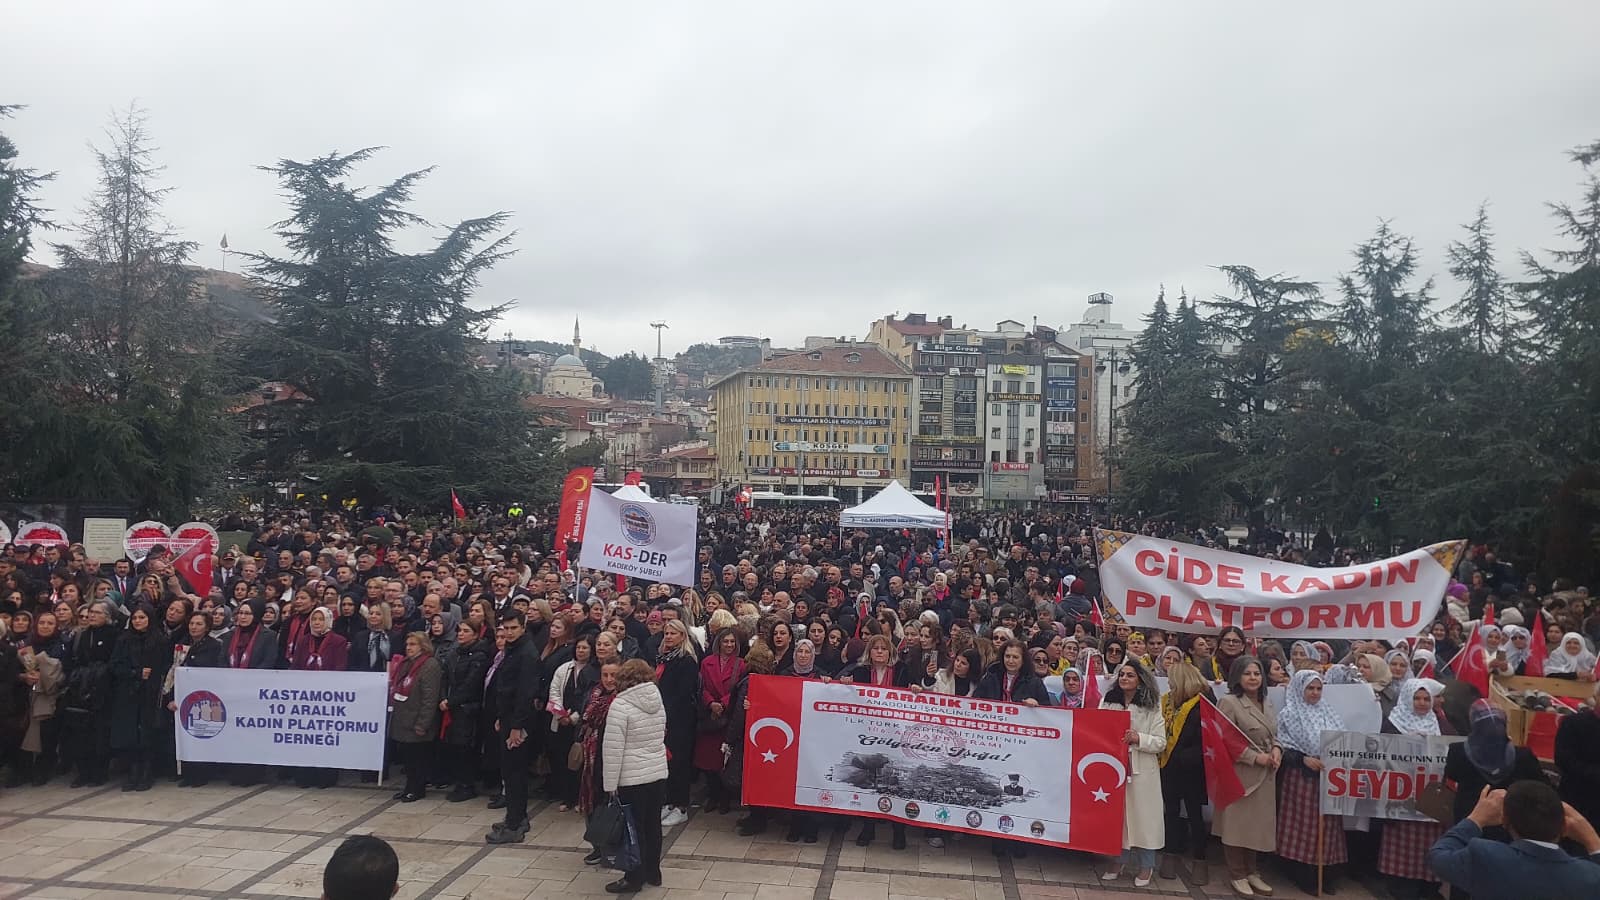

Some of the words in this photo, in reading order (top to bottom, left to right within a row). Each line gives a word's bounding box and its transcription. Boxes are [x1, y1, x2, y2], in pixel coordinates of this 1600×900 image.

[603, 543, 667, 568] KAS-DER
[1134, 547, 1245, 589] CİDE
[1260, 558, 1420, 594] KADIN
[1125, 588, 1422, 631] PLATFORMU
[259, 688, 356, 703] KASTAMONU
[856, 688, 880, 698] 10
[885, 691, 962, 709] ARALIK
[968, 702, 1019, 716] 1919
[866, 699, 917, 710] ANADOLU
[269, 703, 285, 715] 10
[290, 704, 346, 717] ARALIK
[235, 716, 284, 729] KADIN
[288, 719, 379, 734] PLATFORMU
[817, 702, 942, 724] KASTAMONU'DA
[945, 718, 1056, 738] GERÇEKLEŞEN
[273, 732, 340, 746] DERNEĞİ
[858, 734, 941, 752] Gölgeden
